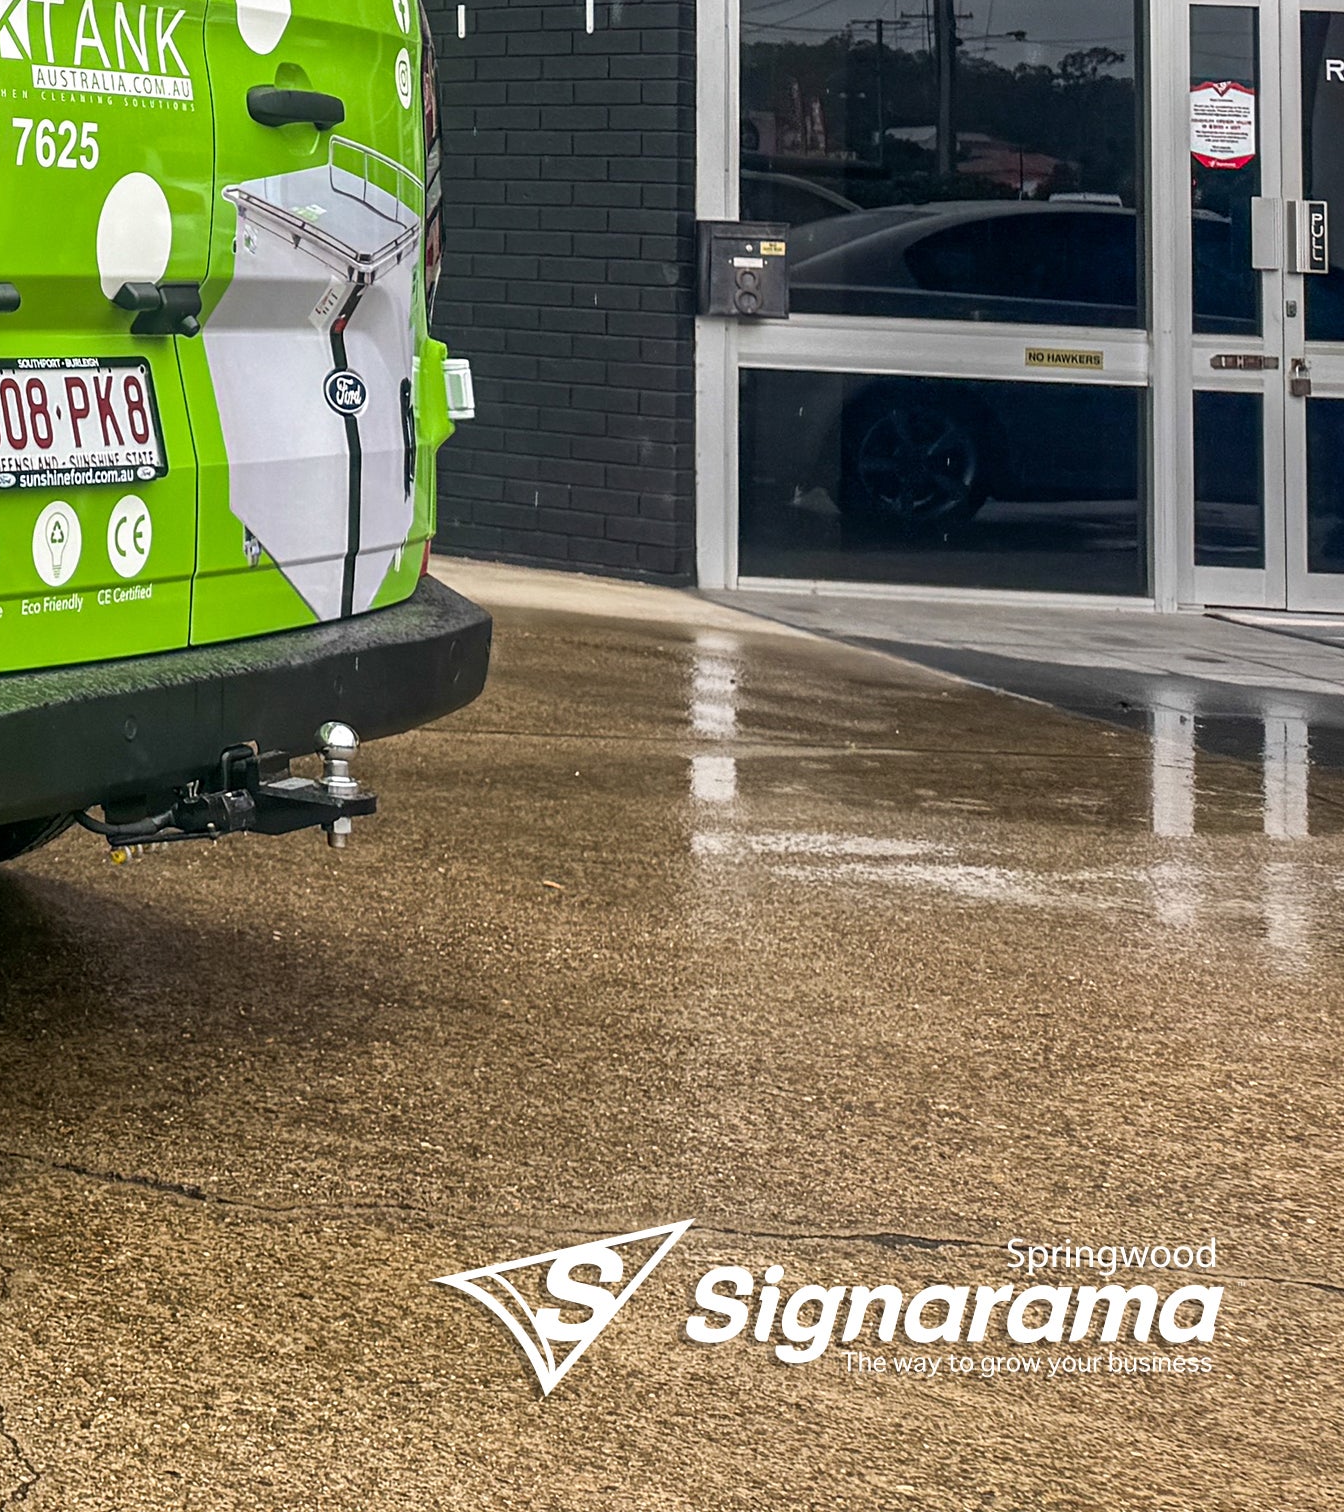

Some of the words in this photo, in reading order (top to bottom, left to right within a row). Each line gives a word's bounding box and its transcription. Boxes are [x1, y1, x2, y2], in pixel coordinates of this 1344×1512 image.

[36, 68, 191, 99] AUSTRALIA.COM.AU
[12, 117, 100, 170] 7625
[1311, 213, 1324, 262] PULL
[17, 358, 61, 369] SOUTHPORT
[1028, 352, 1045, 362] NO
[1047, 353, 1101, 365] HAWKERS
[336, 376, 363, 406] Ford
[125, 450, 155, 465] STATE
[19, 468, 134, 488] sunshineford.com.au
[21, 599, 41, 615] Eco
[43, 593, 83, 612] Friendly
[97, 589, 111, 605] CE
[113, 583, 153, 603] Certified
